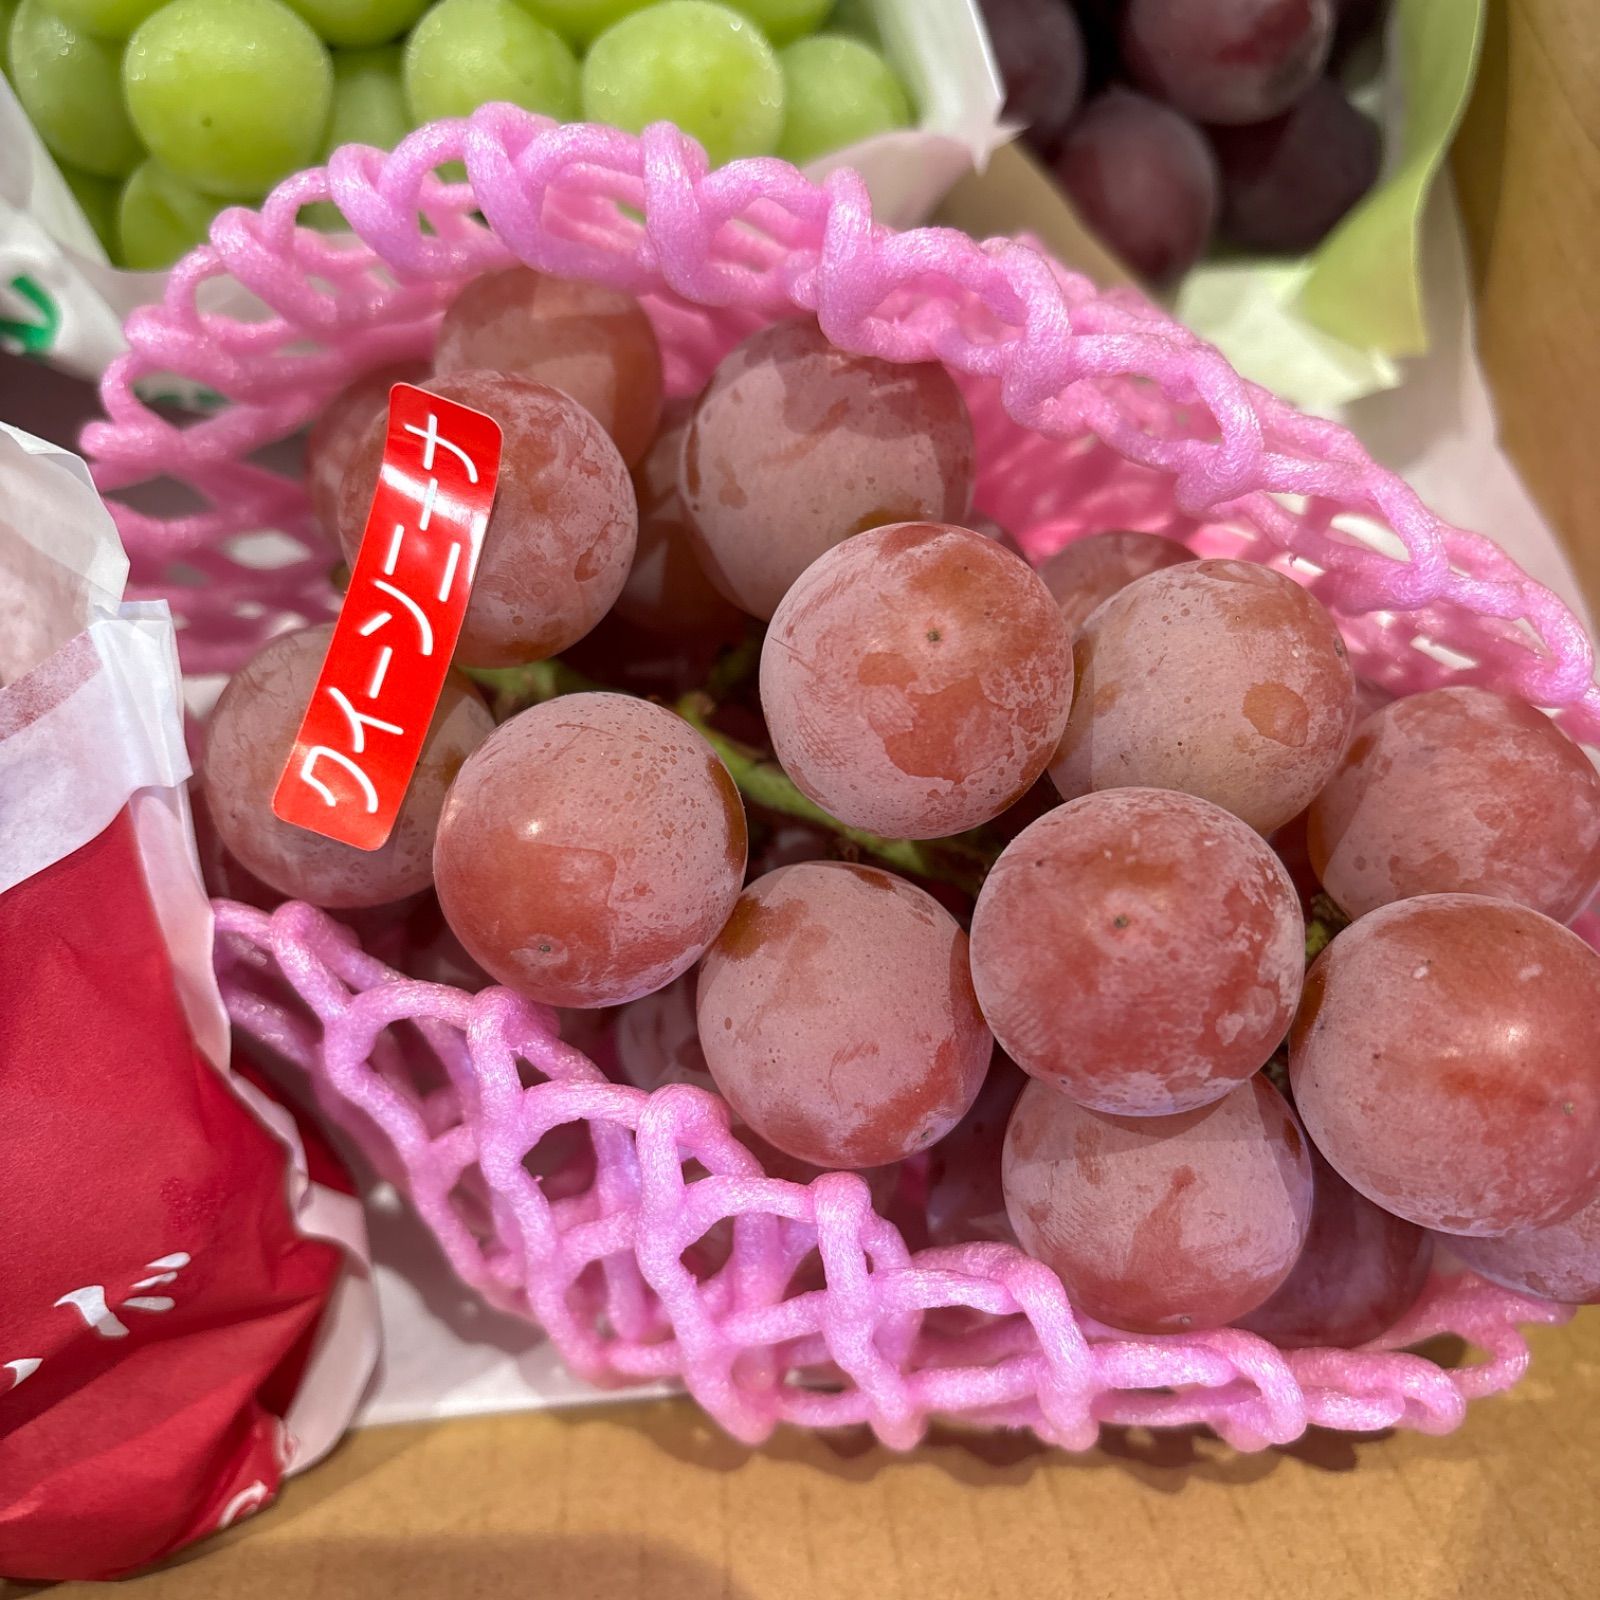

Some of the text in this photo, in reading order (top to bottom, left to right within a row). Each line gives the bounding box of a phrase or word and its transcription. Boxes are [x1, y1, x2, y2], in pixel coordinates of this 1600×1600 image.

[301, 413, 479, 814] クイーンニーナ
